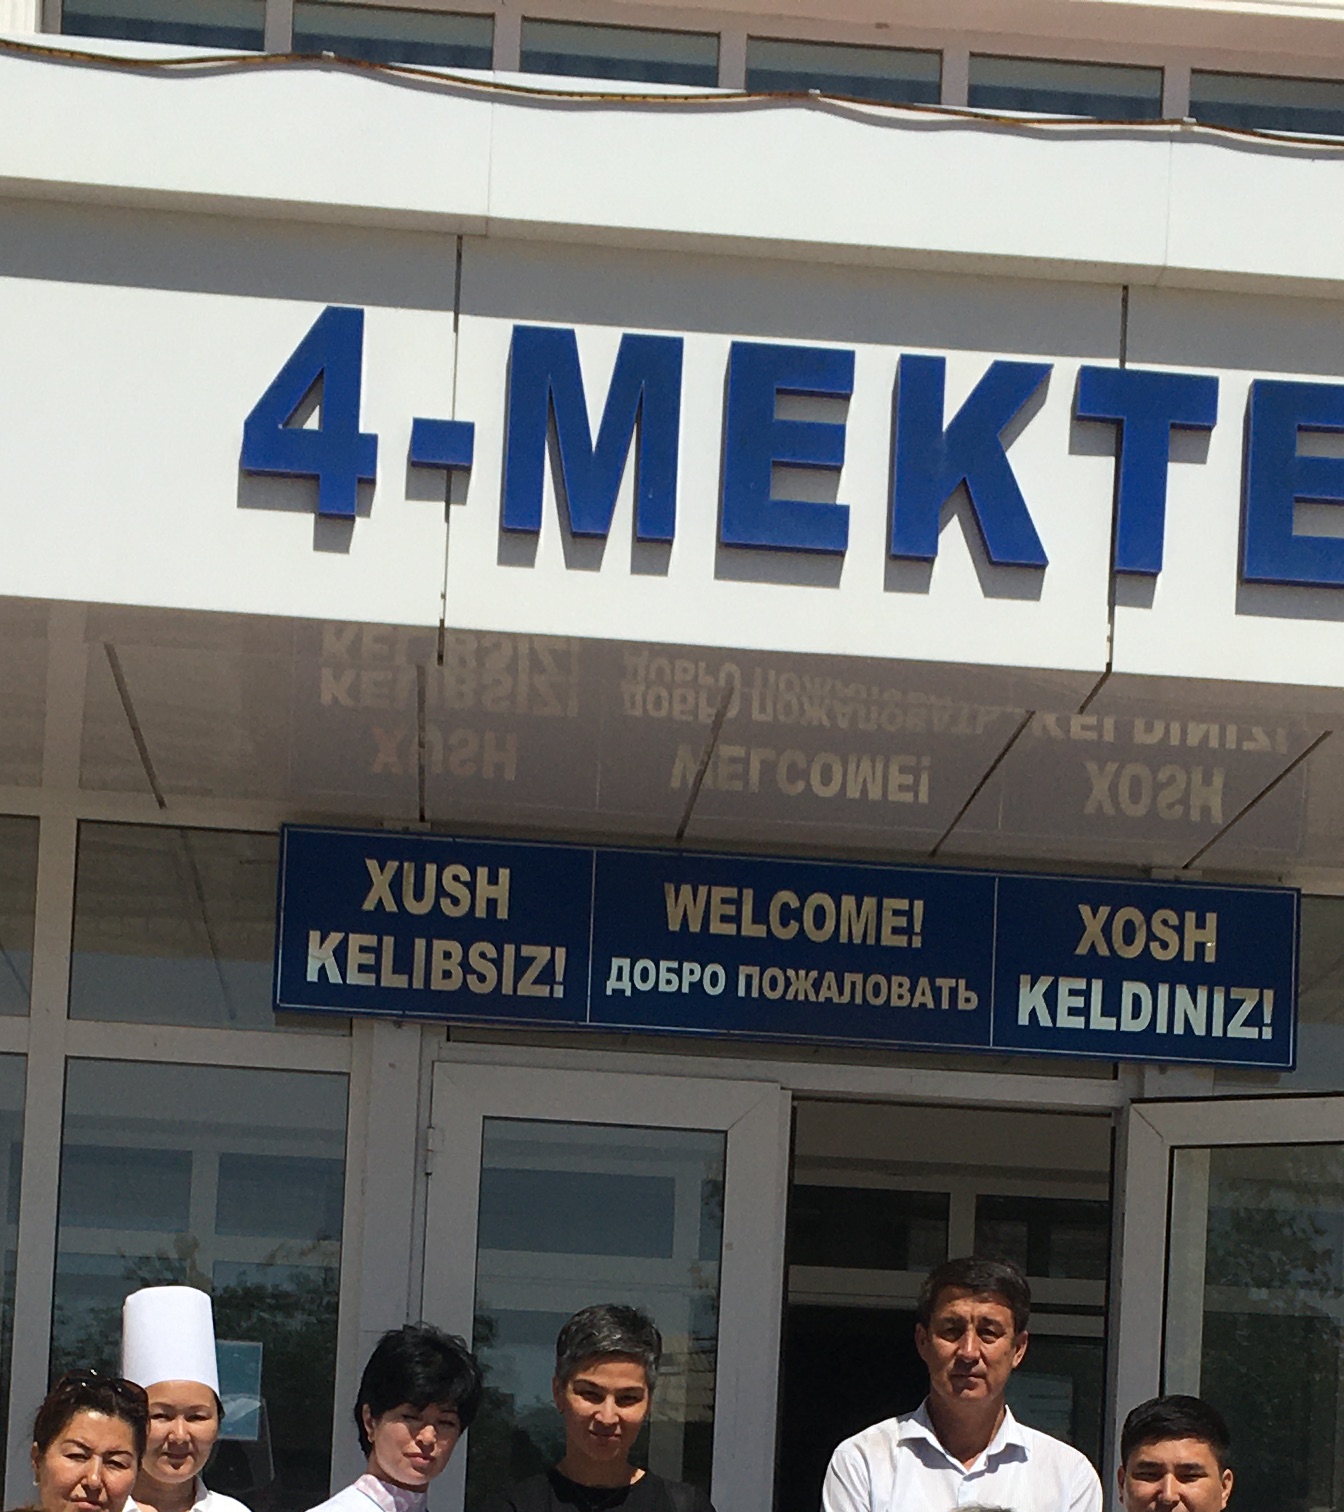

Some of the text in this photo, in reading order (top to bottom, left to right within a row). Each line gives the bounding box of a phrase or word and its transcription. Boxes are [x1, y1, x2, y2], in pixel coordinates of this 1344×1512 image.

[363, 858, 510, 919] XUSH
[665, 884, 925, 949] WELCOME!
[306, 931, 567, 998] KELIBSIZ!
[1076, 904, 1217, 964] XOSH
[606, 957, 979, 1012] ДОБРО ПОЖАЛОВАТЬ
[1017, 975, 1274, 1040] KELDINIZ!
